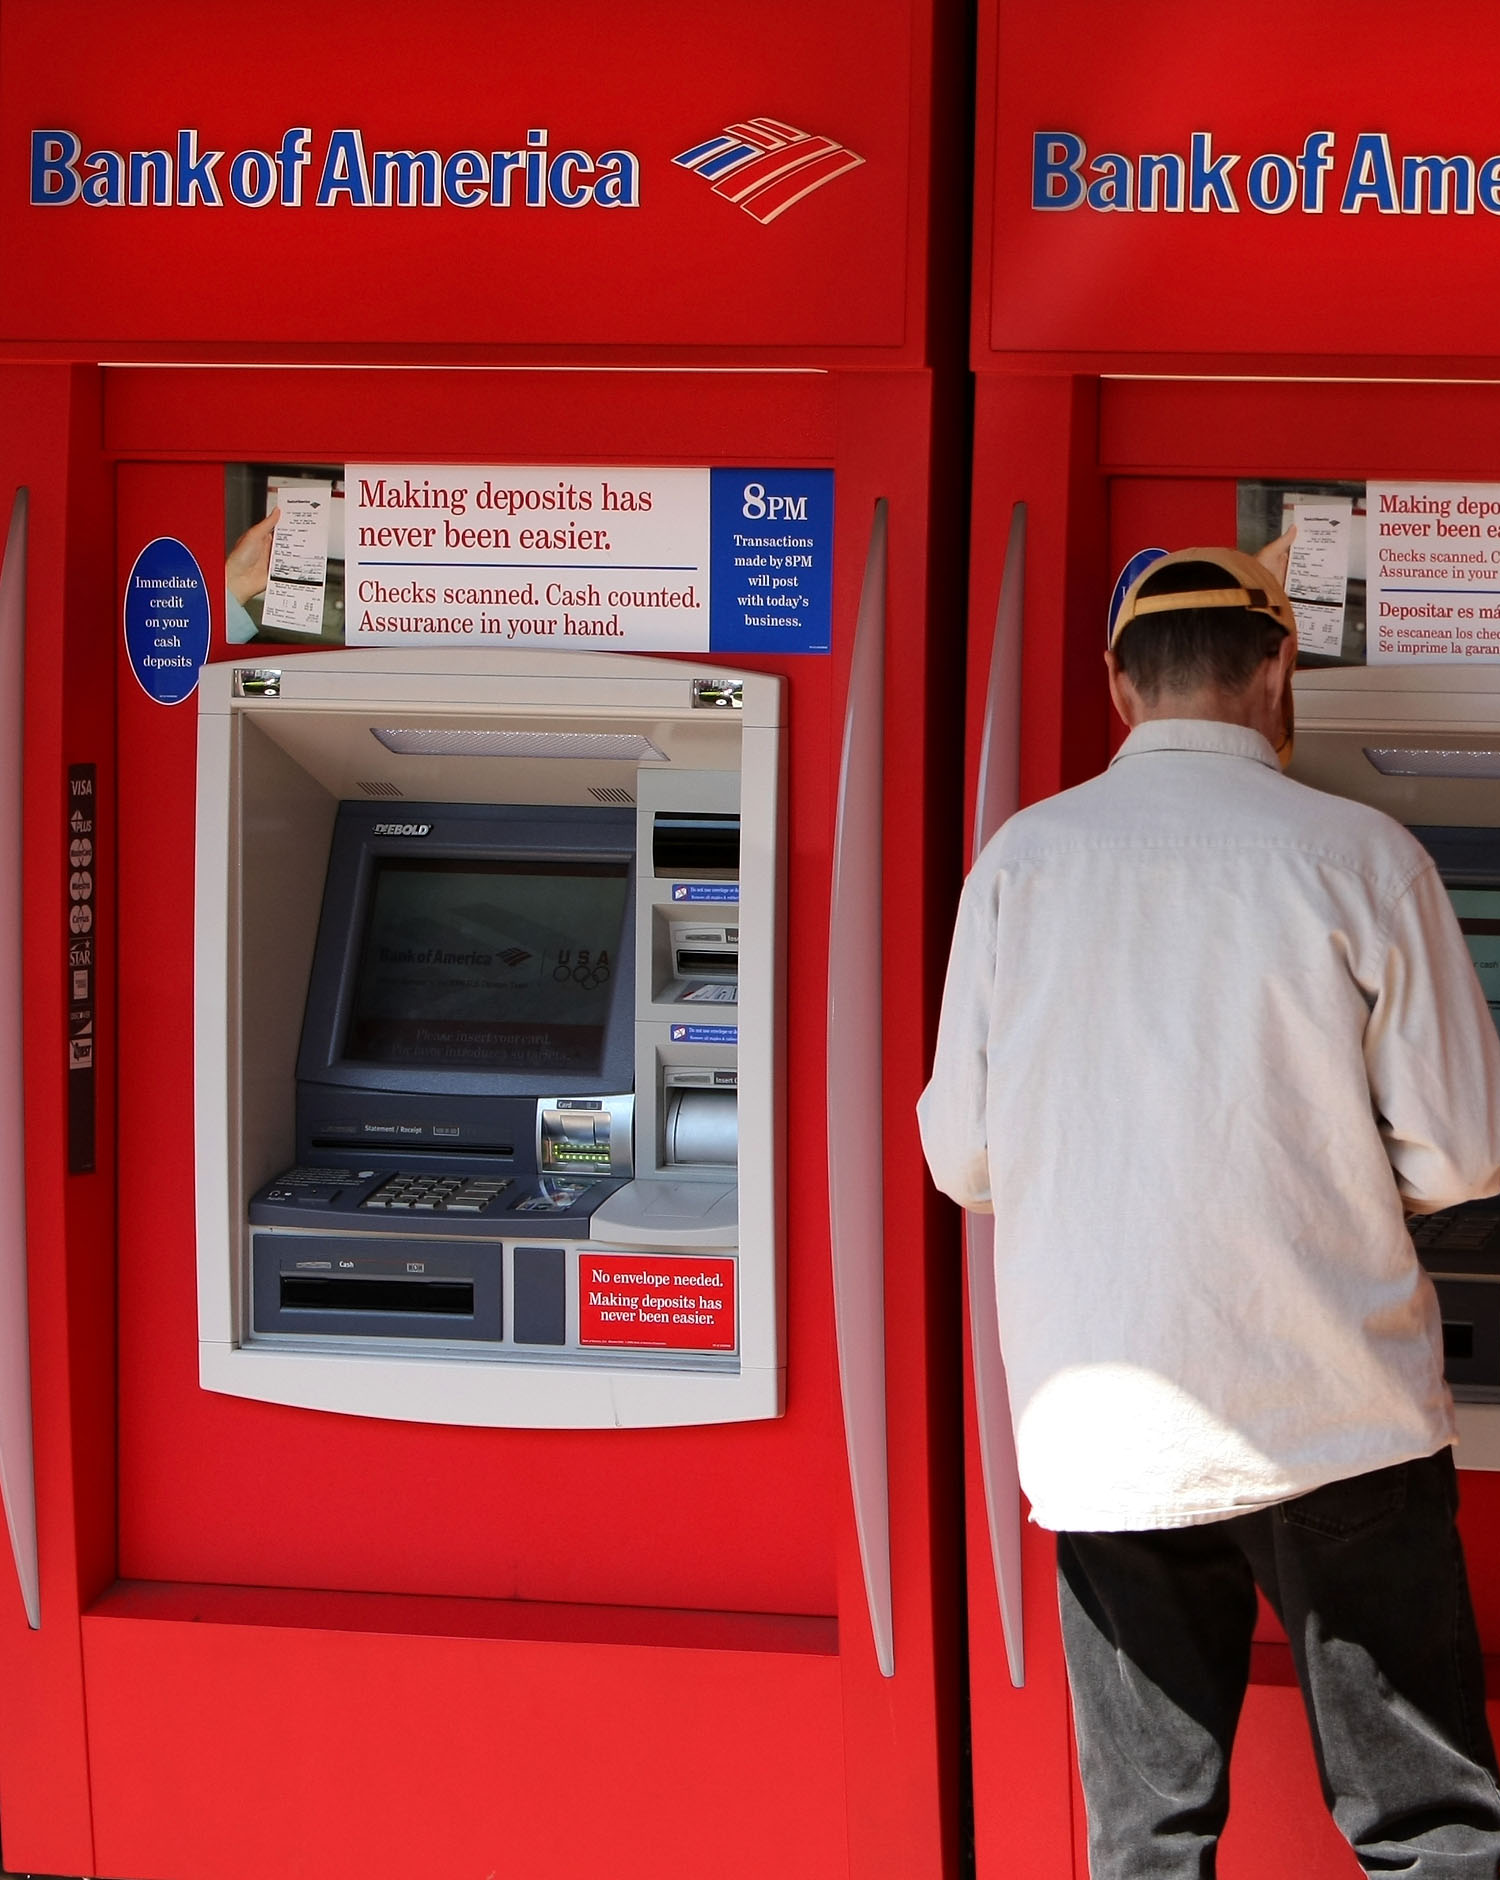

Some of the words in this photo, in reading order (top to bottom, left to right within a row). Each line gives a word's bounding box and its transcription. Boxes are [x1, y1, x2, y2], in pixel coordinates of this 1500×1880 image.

[28, 126, 225, 208] Bank
[228, 125, 313, 209] of
[315, 127, 641, 209] America
[1031, 129, 1241, 214] Bank
[1245, 129, 1336, 215] of
[358, 479, 468, 516] Making
[476, 481, 592, 516] deposits
[601, 482, 652, 511] has
[1378, 494, 1451, 518] Making
[358, 527, 436, 547] never
[443, 520, 511, 548] been
[519, 522, 610, 550] easier.
[1379, 523, 1431, 537] never
[1435, 518, 1481, 538] been
[733, 534, 813, 547] Transactions
[734, 554, 767, 566] made
[769, 554, 783, 569] by
[784, 555, 812, 567] 8PM
[1378, 548, 1426, 562] Checks
[1429, 550, 1487, 563] scanned.
[1378, 564, 1448, 578] Assurance
[1452, 565, 1465, 579] in
[1467, 569, 1498, 582] your
[136, 576, 198, 588] Immediate
[748, 574, 770, 586] will
[772, 576, 798, 589] post
[150, 595, 184, 608] credit
[358, 580, 436, 603] Checks
[443, 583, 539, 605] scanned.
[546, 583, 601, 606] Cash
[608, 585, 700, 608] counted.
[737, 594, 764, 606] with
[766, 594, 809, 609] today's
[1379, 601, 1454, 620] Depositar
[1457, 607, 1474, 619] es
[145, 618, 160, 627] on
[162, 618, 189, 630] your
[358, 610, 473, 633] Assurance
[480, 612, 502, 634] in
[506, 619, 557, 639] your
[563, 613, 624, 636] hand.
[744, 613, 802, 627] business.
[1378, 625, 1394, 638] Se
[1396, 629, 1453, 639] escanean
[1455, 626, 1473, 639] los
[153, 634, 180, 647] cash
[1378, 640, 1394, 652] Se
[1397, 641, 1448, 655] imprime
[1451, 641, 1462, 654] la
[143, 654, 192, 669] deposits
[70, 779, 92, 796] VISA
[374, 824, 429, 836] DIEBOLD
[70, 950, 91, 965] STAR
[364, 1124, 395, 1133] Statement
[400, 1126, 422, 1134] Receipt
[339, 1260, 354, 1268] Cash
[592, 1269, 611, 1283] No
[613, 1271, 670, 1287] envelope
[673, 1272, 723, 1287] needed.
[589, 1292, 639, 1309] Making
[641, 1294, 695, 1310] deposits
[699, 1295, 722, 1309] has
[600, 1311, 636, 1321] never
[638, 1309, 669, 1323] been
[672, 1310, 714, 1324] easier.
